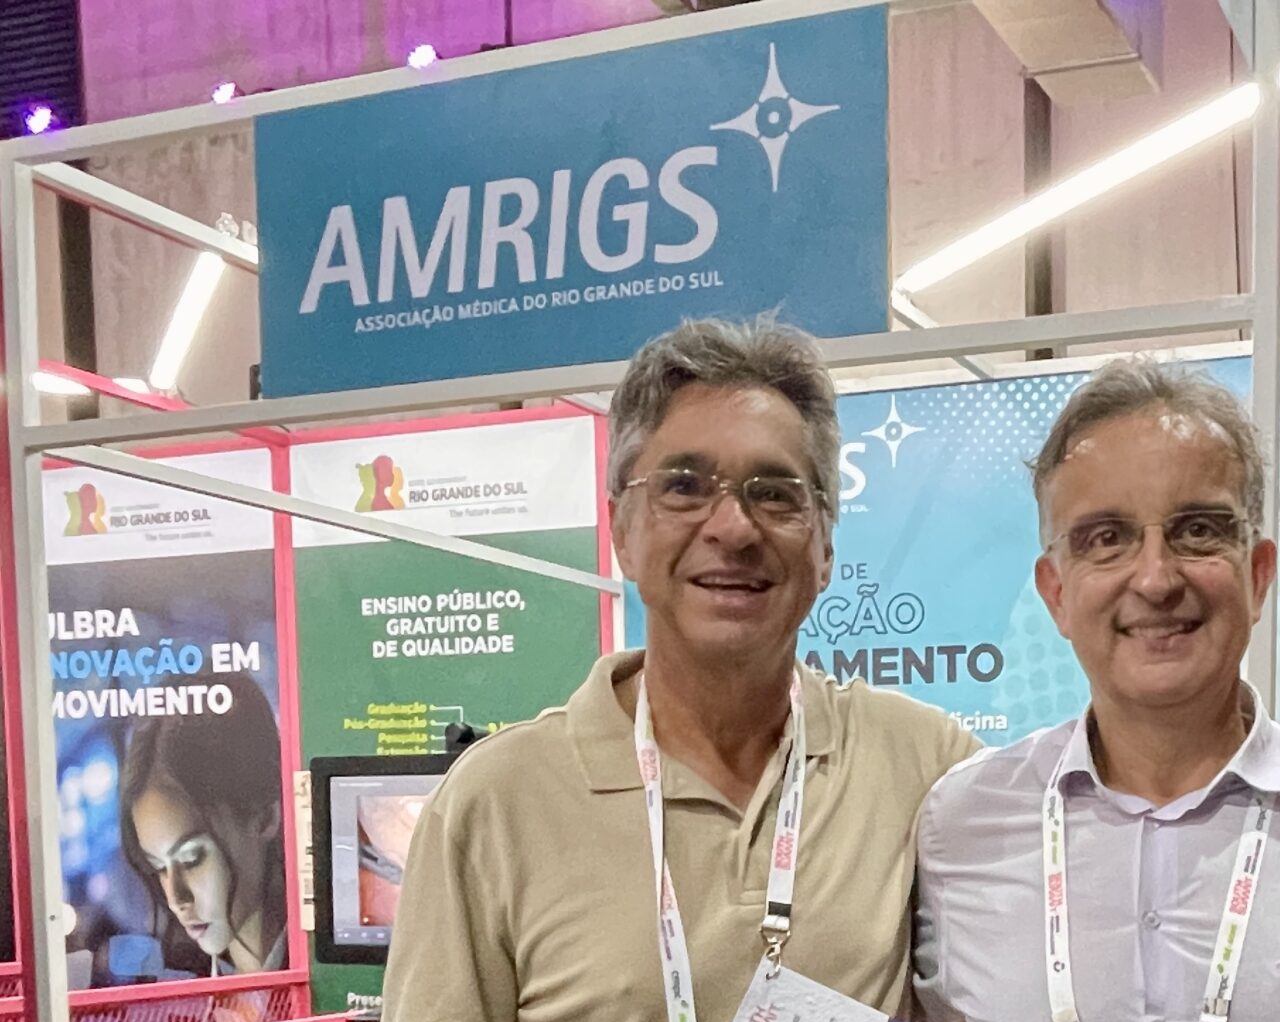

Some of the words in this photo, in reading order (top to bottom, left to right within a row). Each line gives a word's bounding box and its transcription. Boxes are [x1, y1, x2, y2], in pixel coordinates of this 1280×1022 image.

[299, 145, 719, 314] AMRIGS
[354, 304, 454, 333] ASSOCIAÇÃO
[458, 297, 520, 321] MÉDICA
[523, 294, 548, 312] DO
[551, 289, 581, 308] RIO
[583, 280, 655, 303] GRANDE
[658, 276, 685, 293] DO
[688, 271, 724, 288] SUL
[408, 489, 430, 503] RIO
[431, 484, 481, 501] GRANDE
[483, 483, 502, 498] DO
[503, 481, 528, 496] SUL
[129, 511, 172, 526] GRANDE
[174, 510, 189, 523] DO
[191, 508, 212, 521] SUL
[841, 563, 868, 581] DE
[361, 594, 432, 616] ENSINO
[436, 588, 526, 612] PÚBLICO,
[386, 613, 482, 636] GRATUITO
[487, 613, 500, 632] E
[211, 641, 260, 673] EM
[372, 640, 398, 659] DE
[402, 634, 515, 657] QUALIDADE
